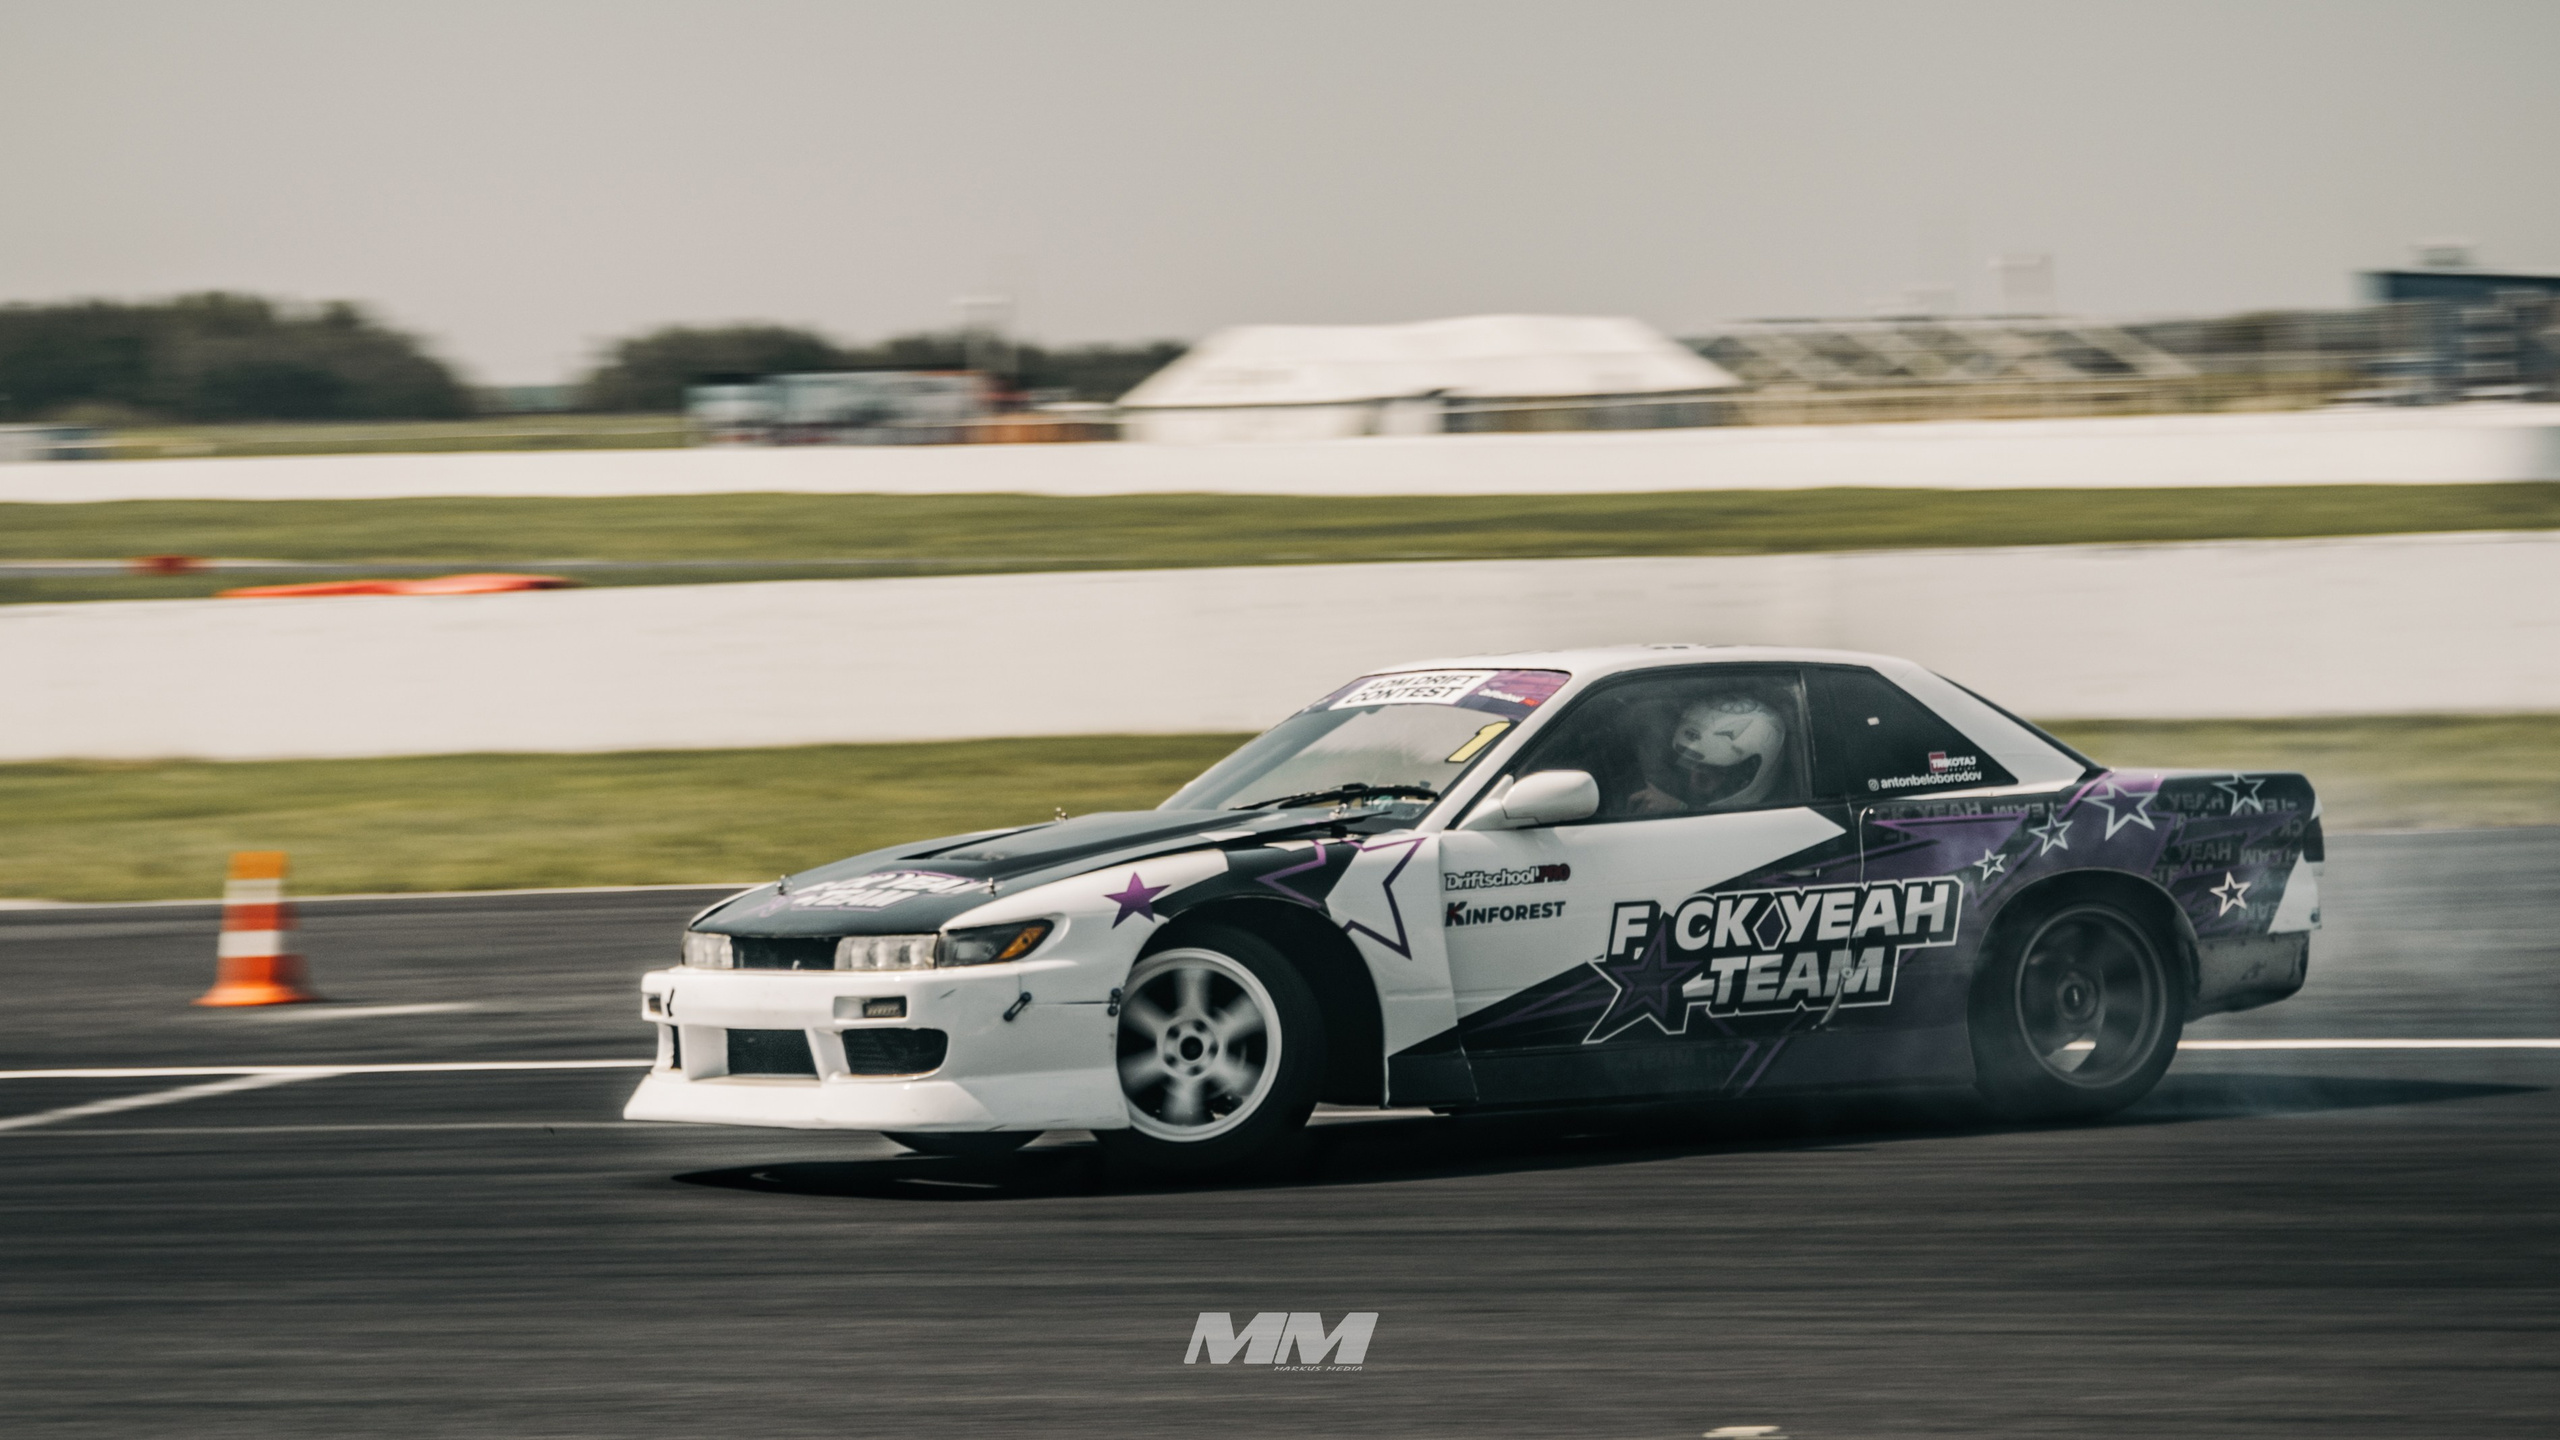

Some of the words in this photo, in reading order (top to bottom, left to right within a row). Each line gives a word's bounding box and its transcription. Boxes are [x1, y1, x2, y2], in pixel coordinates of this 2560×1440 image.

[1412, 675, 1481, 685] DRIFT
[1345, 687, 1464, 704] CONTEST
[1880, 770, 1983, 790] antonbeloborodov
[1445, 900, 1567, 927] KINFOREST
[1611, 897, 1752, 956] FCK
[1779, 883, 1950, 944] YEAH
